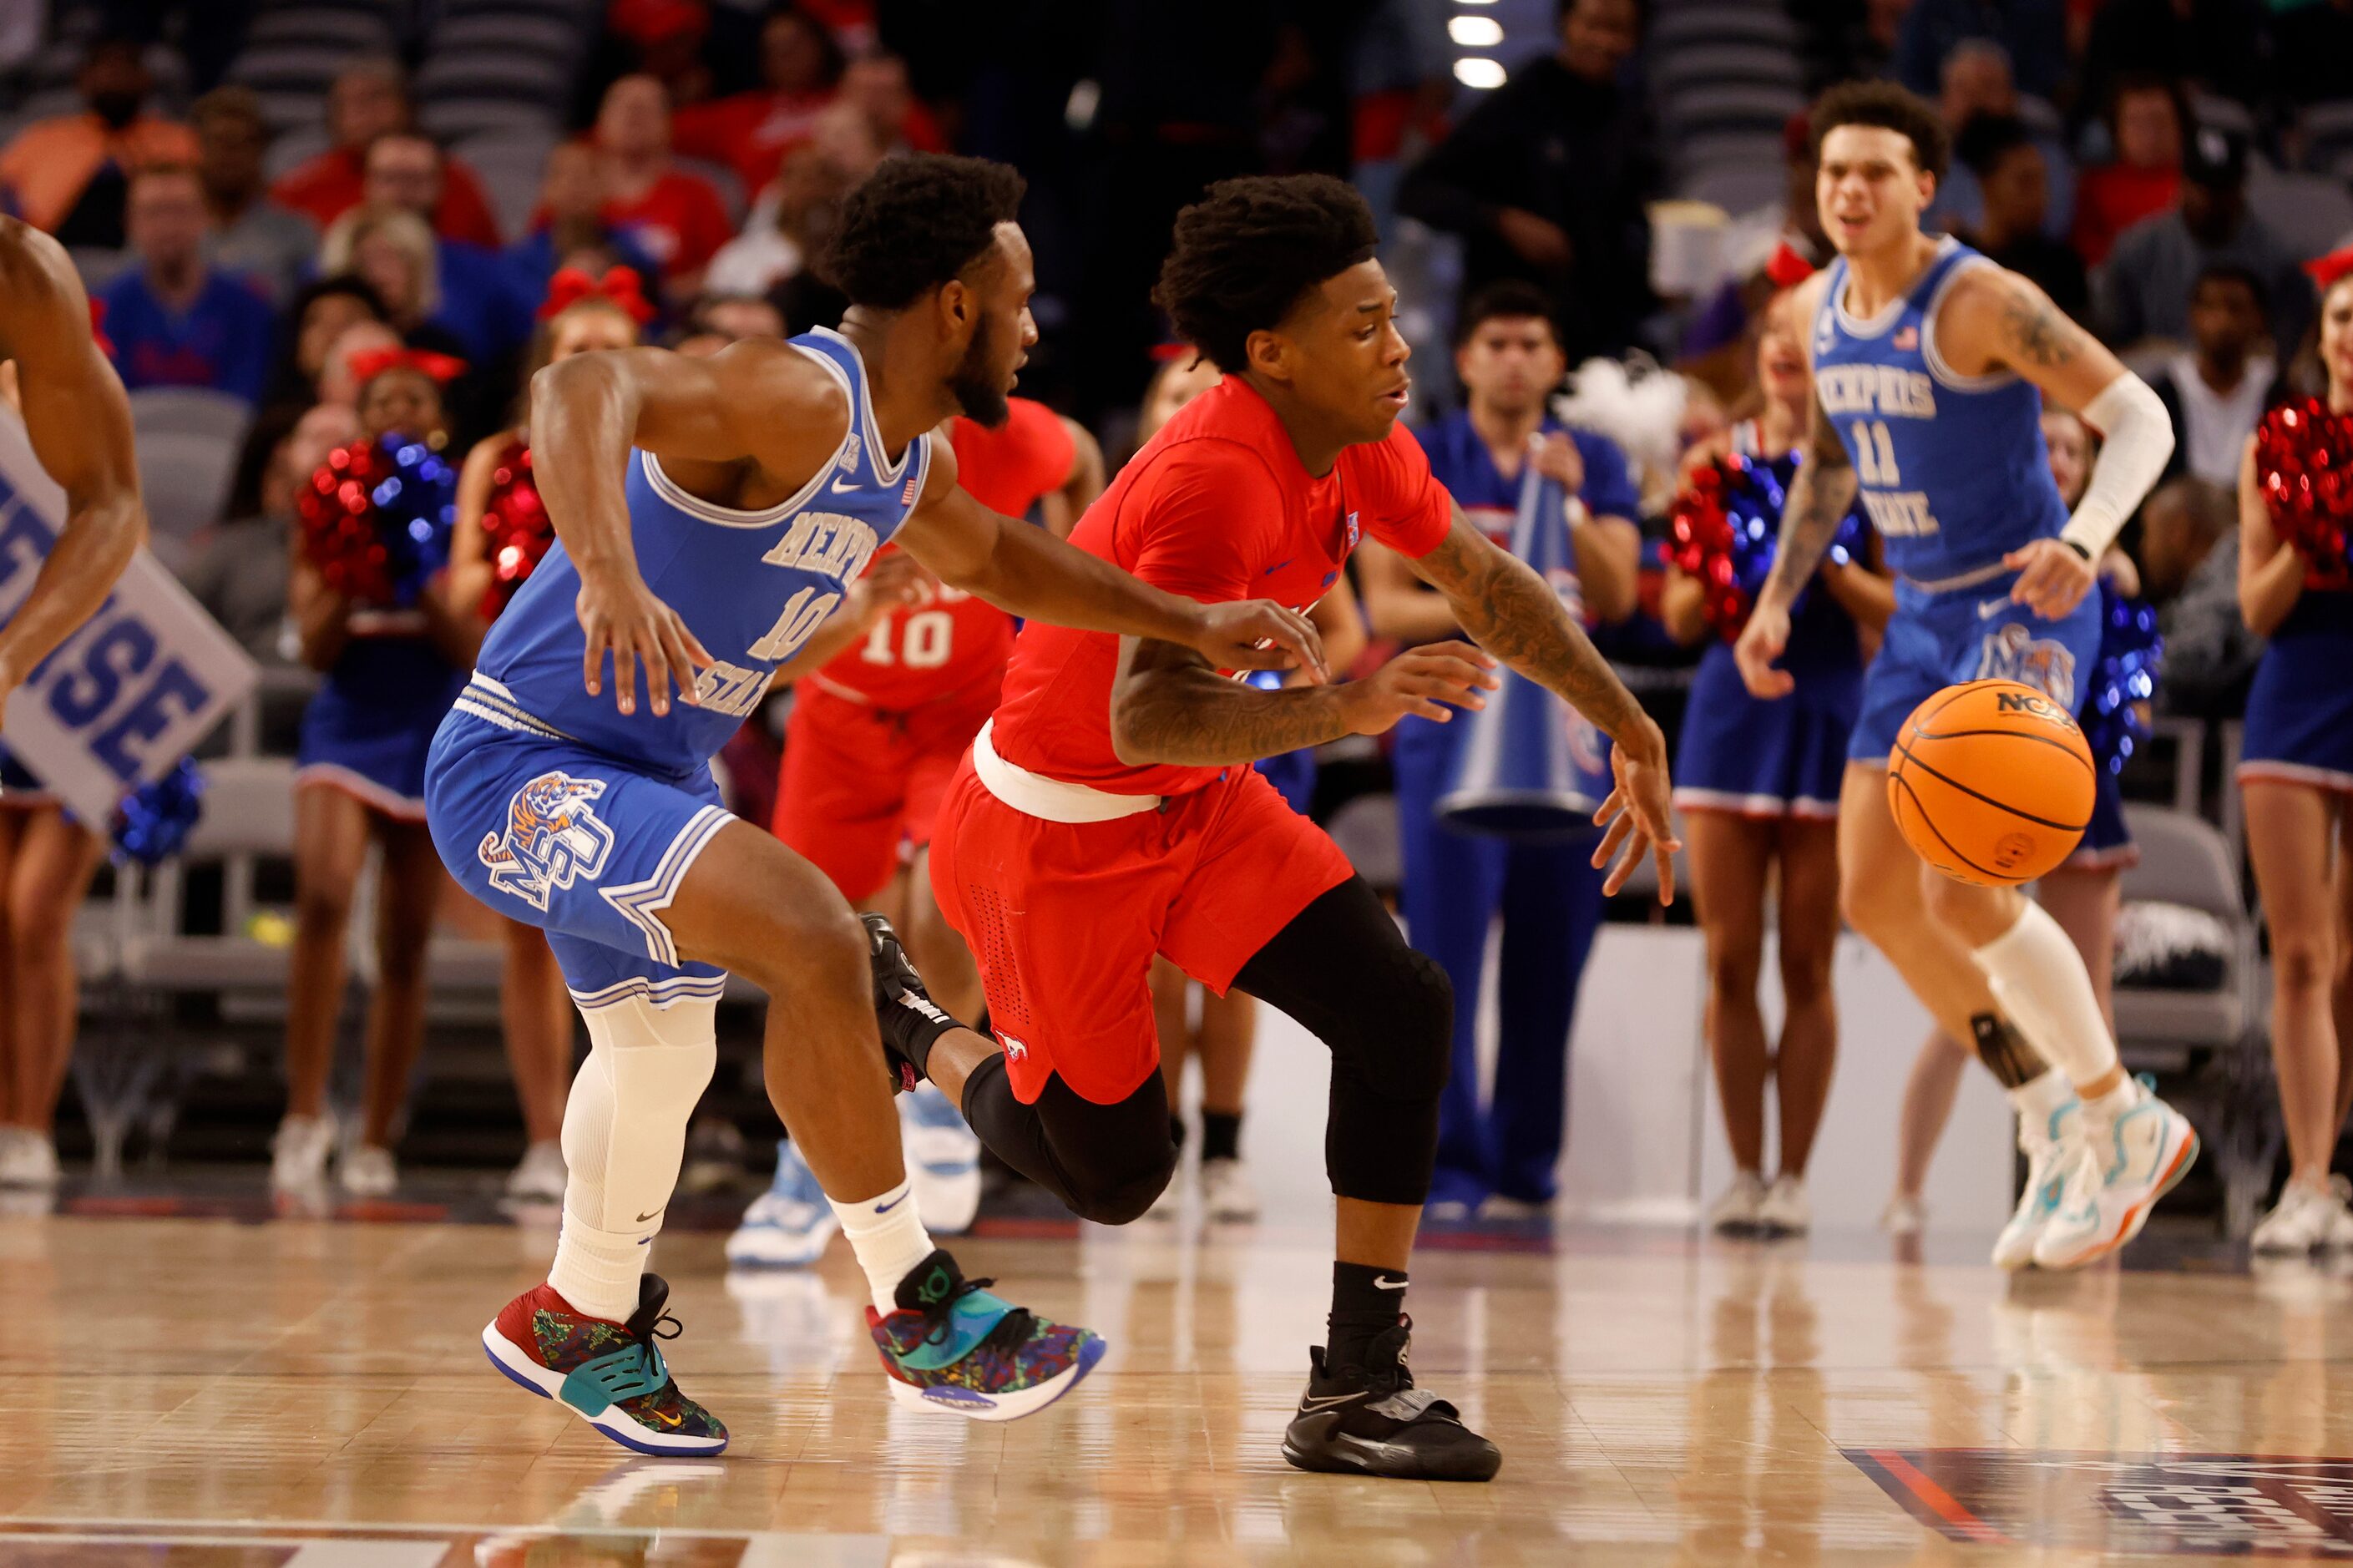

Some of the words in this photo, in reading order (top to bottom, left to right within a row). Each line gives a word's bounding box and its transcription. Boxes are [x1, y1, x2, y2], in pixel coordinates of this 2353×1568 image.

[1851, 419, 1900, 487] 11
[747, 586, 841, 661] 10
[861, 610, 954, 667] 10
